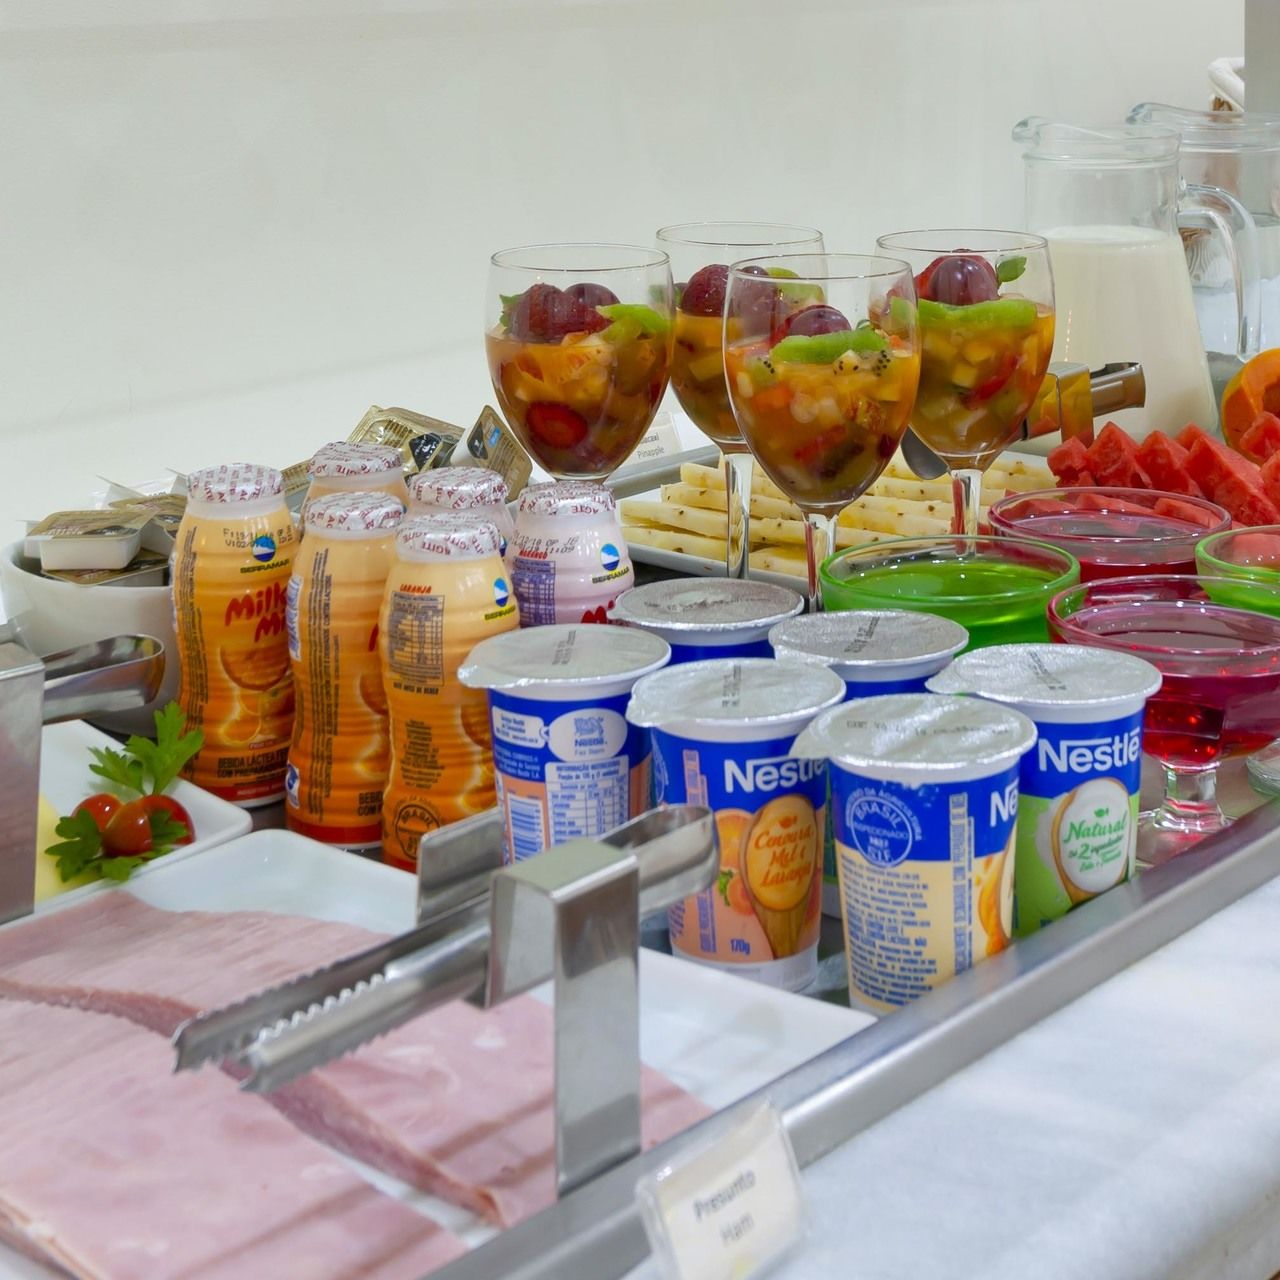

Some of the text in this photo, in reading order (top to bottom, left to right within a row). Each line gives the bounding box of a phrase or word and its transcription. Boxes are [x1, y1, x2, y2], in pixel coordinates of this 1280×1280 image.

[1038, 727, 1142, 774] Nestlé
[359, 792, 384, 805] BEBID
[854, 801, 904, 830] BRASIL
[1063, 810, 1128, 844] Natural
[730, 937, 751, 956] 170g
